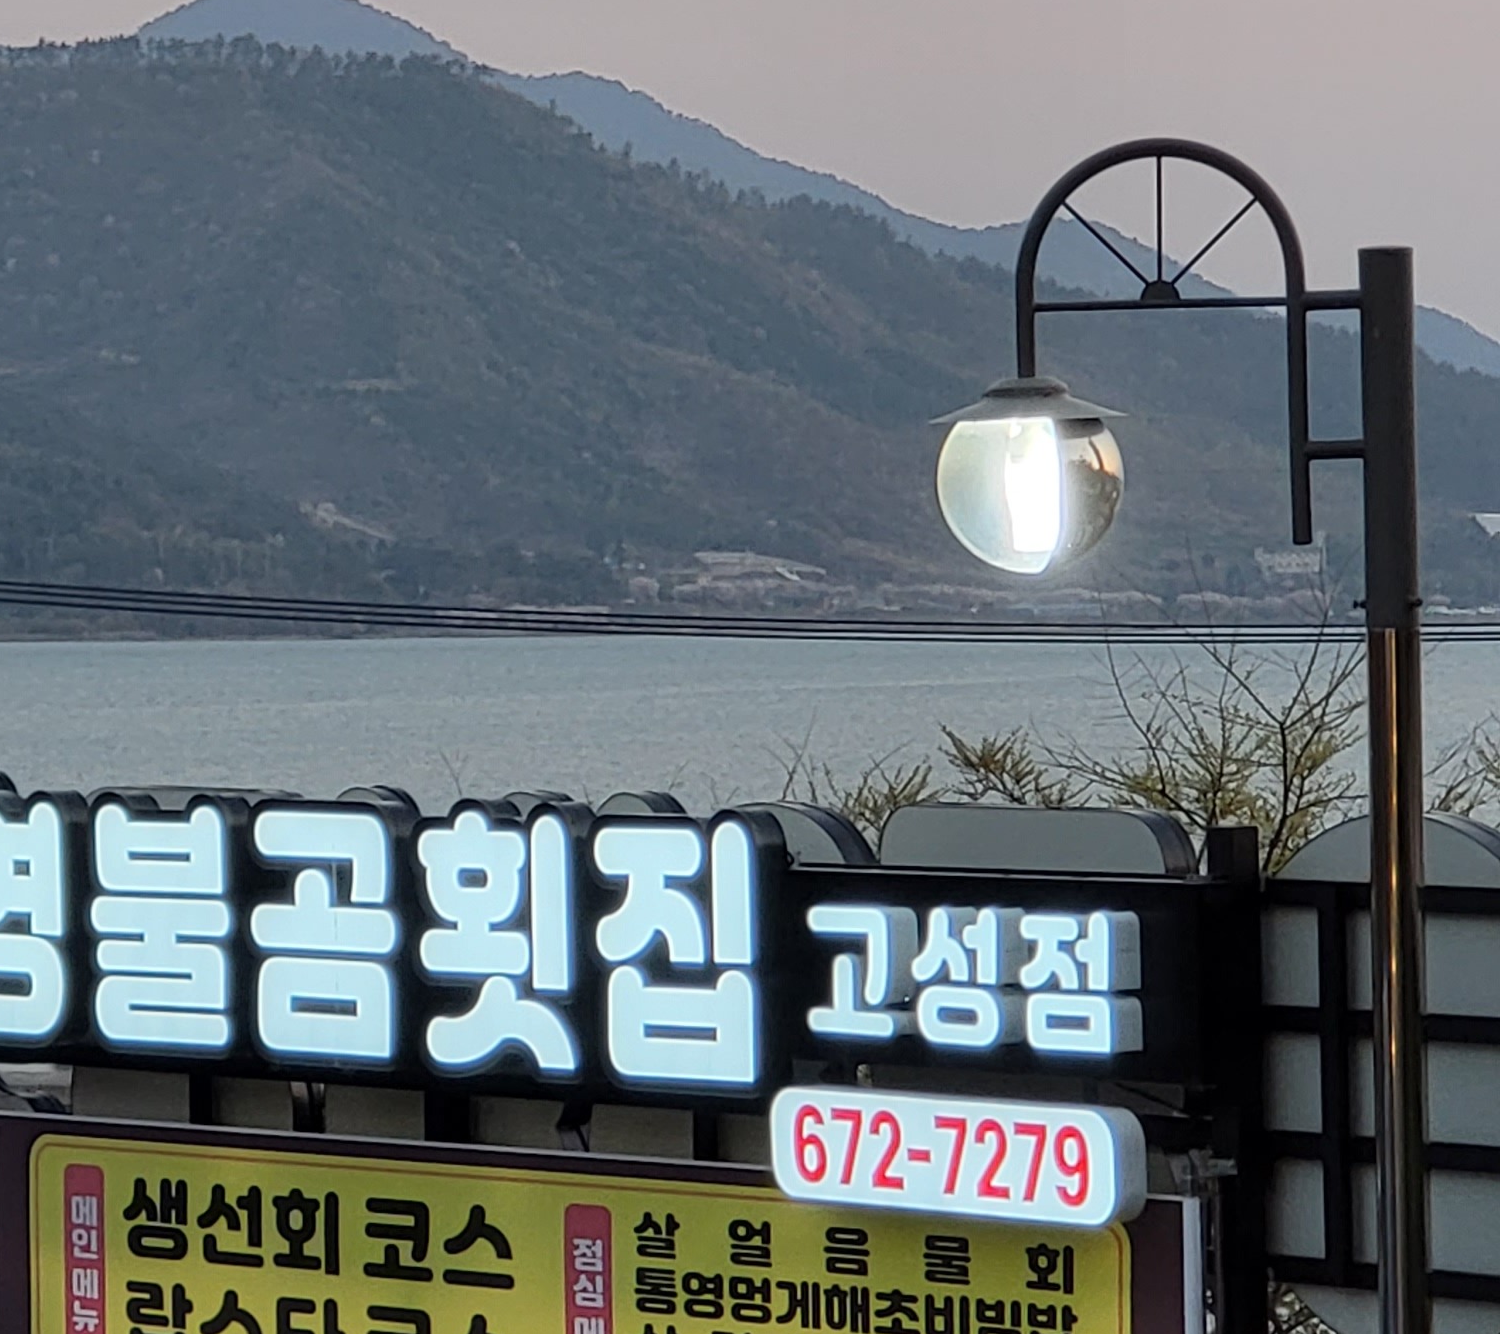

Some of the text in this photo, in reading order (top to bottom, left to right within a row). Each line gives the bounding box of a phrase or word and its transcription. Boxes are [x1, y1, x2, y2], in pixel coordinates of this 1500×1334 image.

[807, 906, 1112, 1054] 고성점
[793, 1104, 1091, 1208] 672-7279
[71, 1194, 100, 1333] 메인 메뉴
[122, 1177, 515, 1290] 생선회 코스
[572, 1238, 604, 1309] 점심
